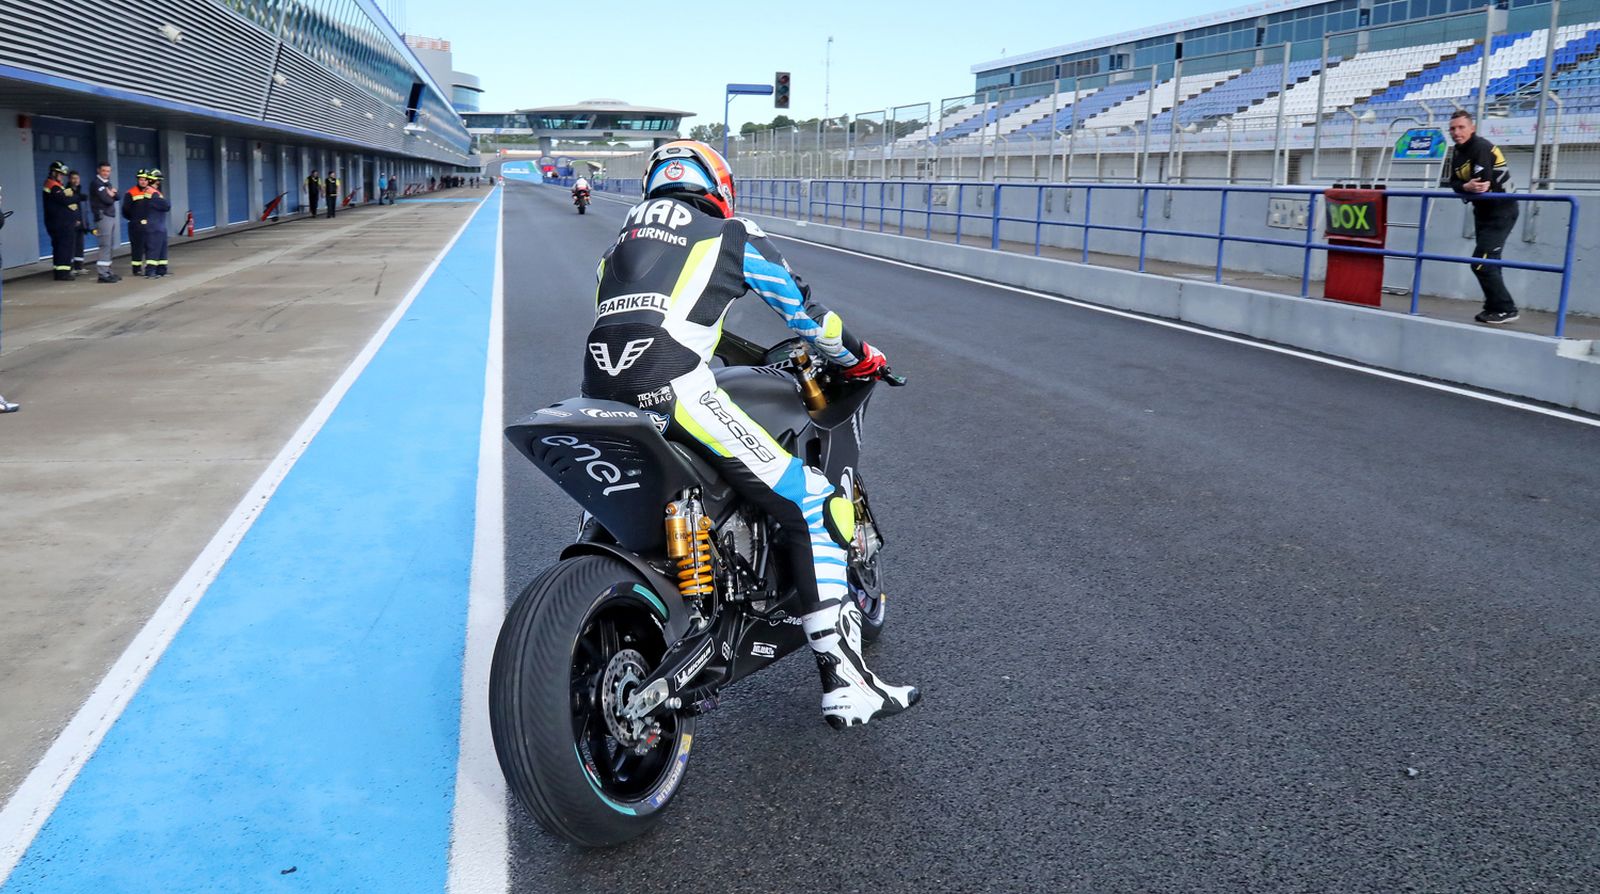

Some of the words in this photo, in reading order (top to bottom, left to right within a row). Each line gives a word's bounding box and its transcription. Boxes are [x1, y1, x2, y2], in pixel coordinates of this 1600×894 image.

[621, 200, 692, 230] MAP
[1330, 204, 1370, 230] BOX
[631, 227, 687, 247] TURNING
[600, 296, 668, 314] BARIKELL
[541, 435, 641, 497] enel
